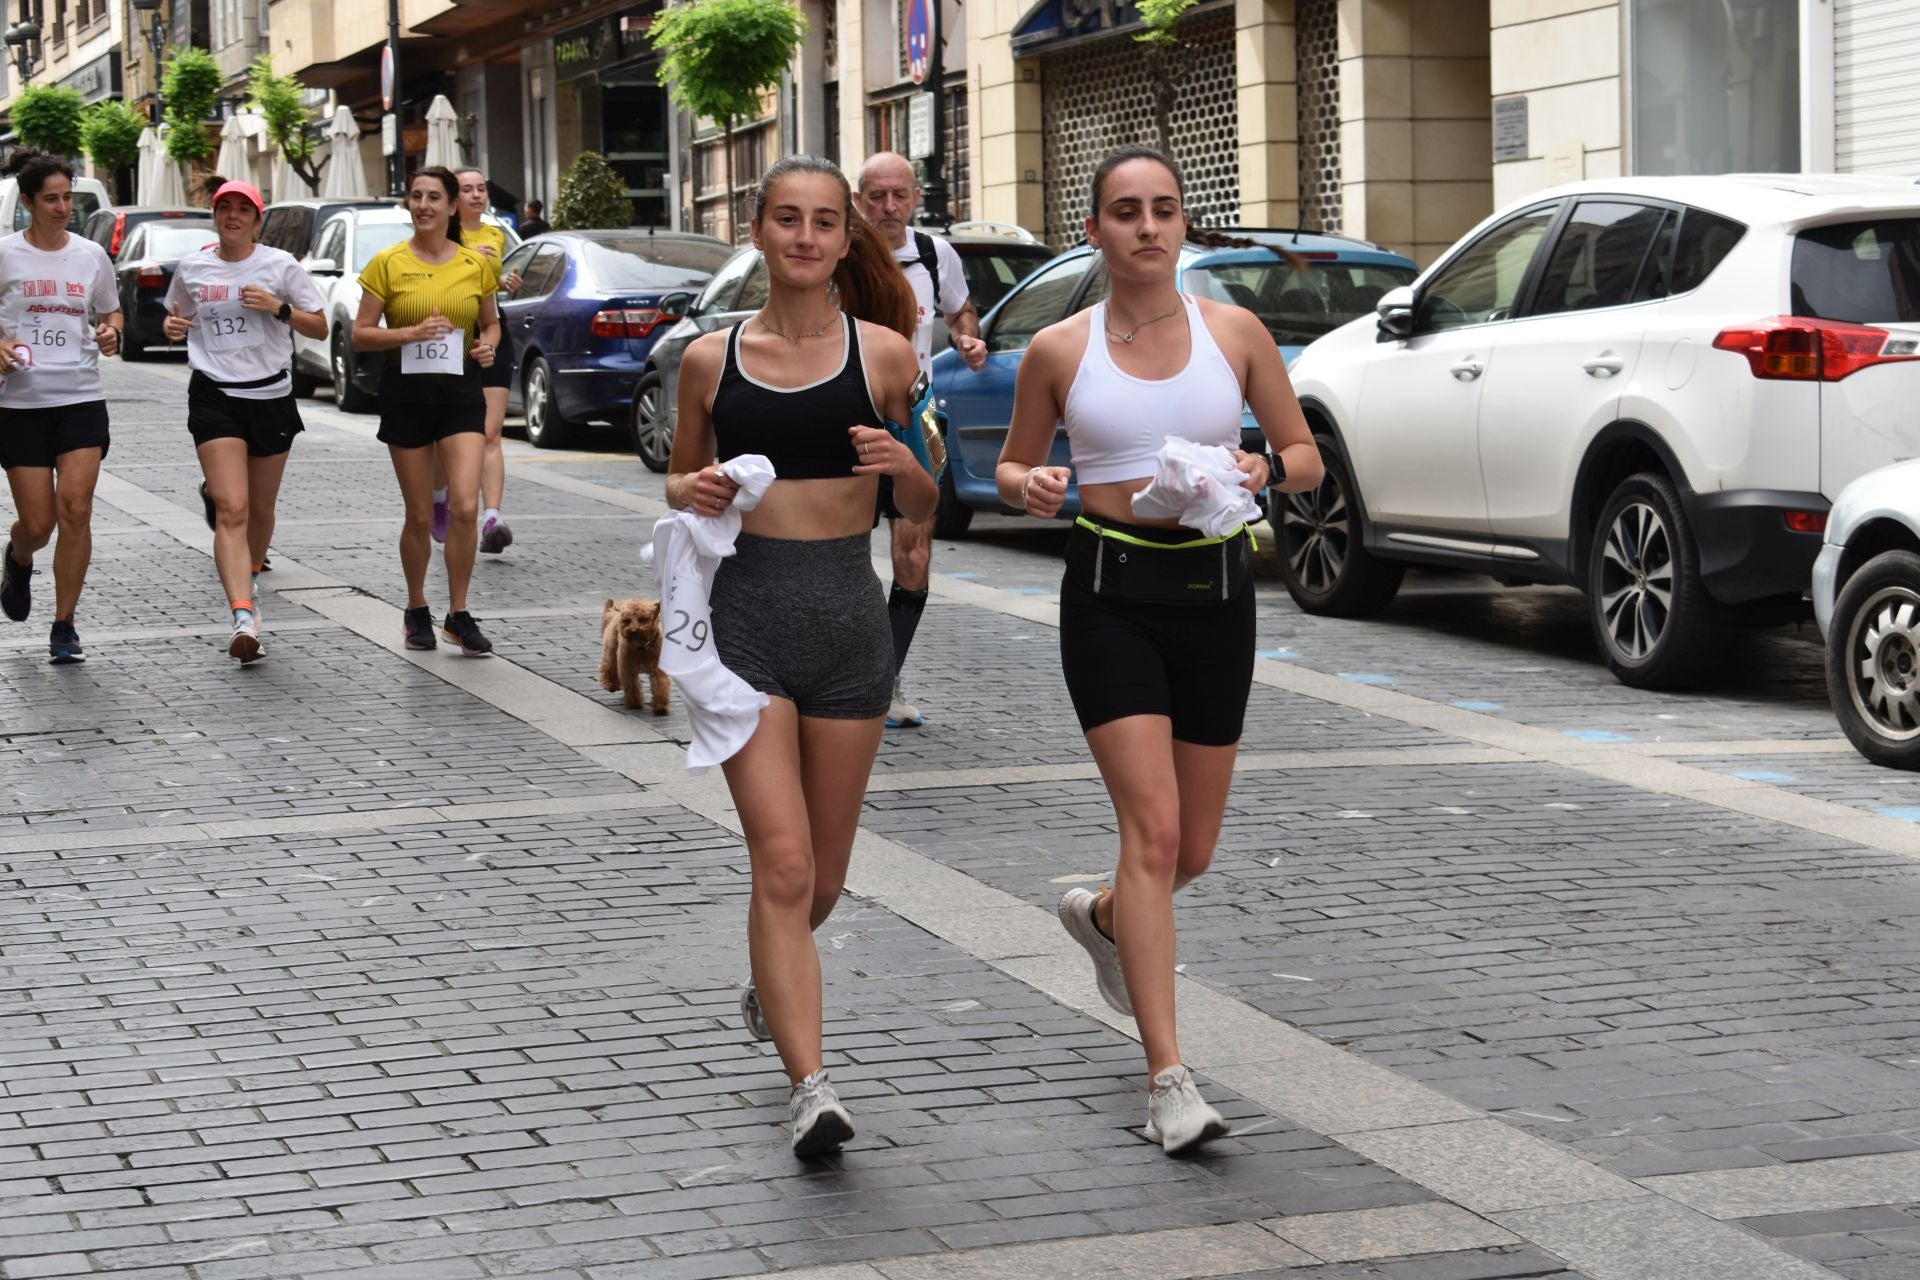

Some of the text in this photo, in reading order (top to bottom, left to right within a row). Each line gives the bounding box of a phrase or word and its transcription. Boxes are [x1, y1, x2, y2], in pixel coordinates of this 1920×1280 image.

[213, 316, 248, 337] 132
[31, 328, 67, 347] 166
[414, 343, 449, 360] 162
[665, 609, 708, 652] 29
